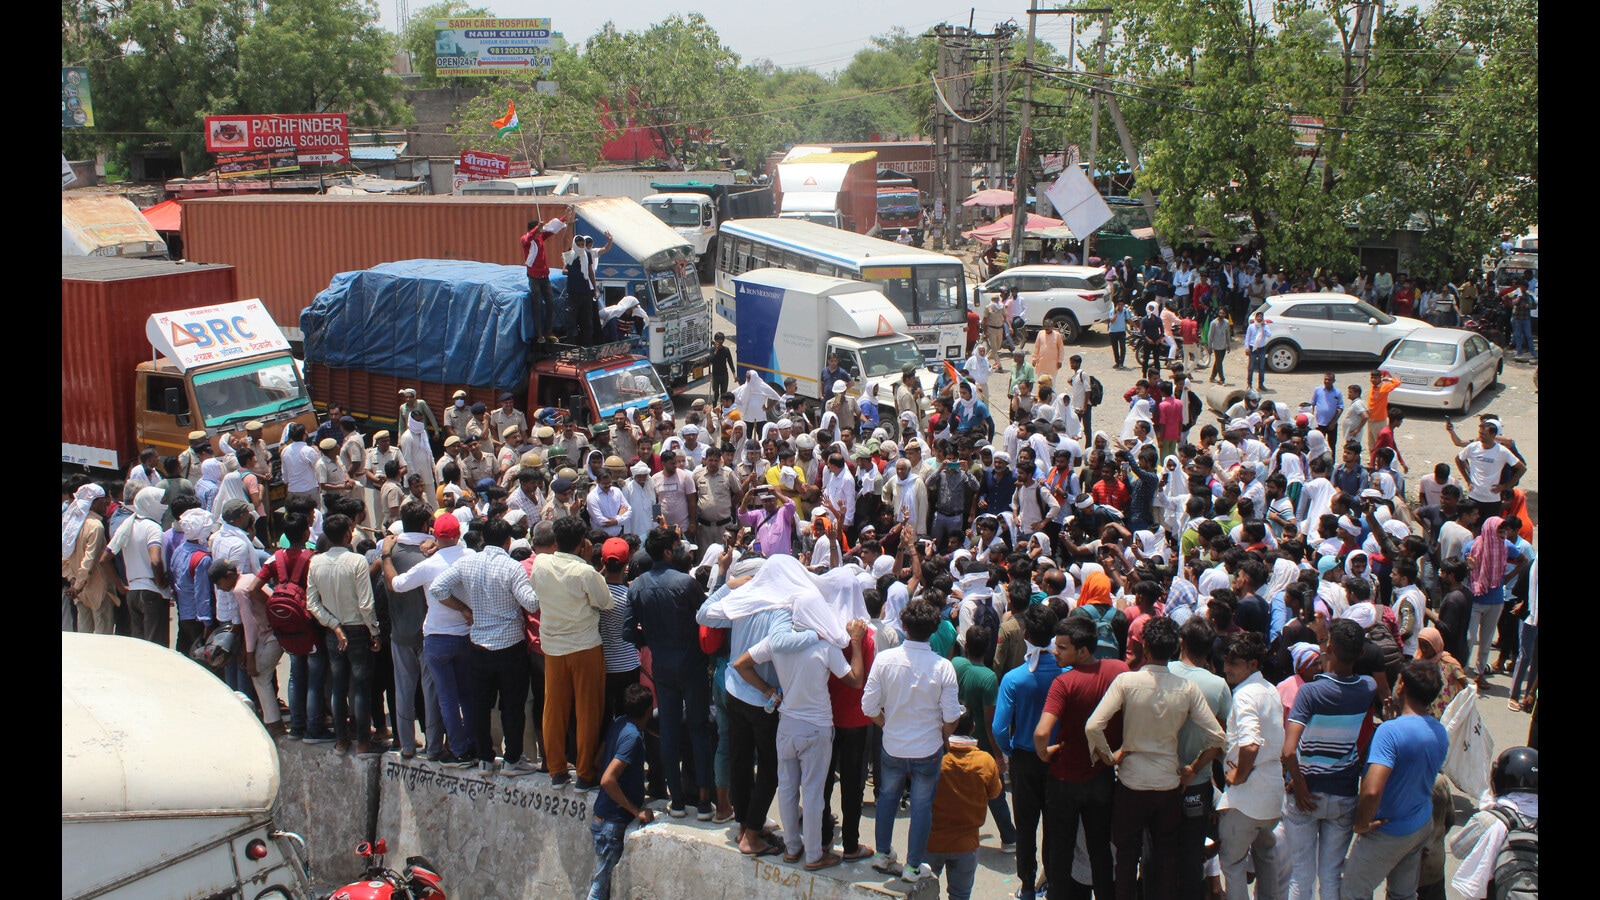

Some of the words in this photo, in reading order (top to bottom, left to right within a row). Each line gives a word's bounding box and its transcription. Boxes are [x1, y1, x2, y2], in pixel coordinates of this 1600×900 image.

[449, 20, 472, 28] SADH
[474, 20, 497, 28] CARE
[499, 19, 539, 28] HOSPITAL
[500, 30, 546, 38] CERTIFIED
[437, 58, 458, 66] OPEN
[460, 57, 477, 66] 24x7
[252, 118, 343, 134] PATHFINDER
[253, 136, 297, 148] GLOBAL
[300, 134, 344, 147] SCHOOL
[464, 154, 506, 170] बीकानेर
[746, 288, 757, 296] IRON
[184, 316, 257, 349] BRC
[406, 763, 436, 793] मुक्ति
